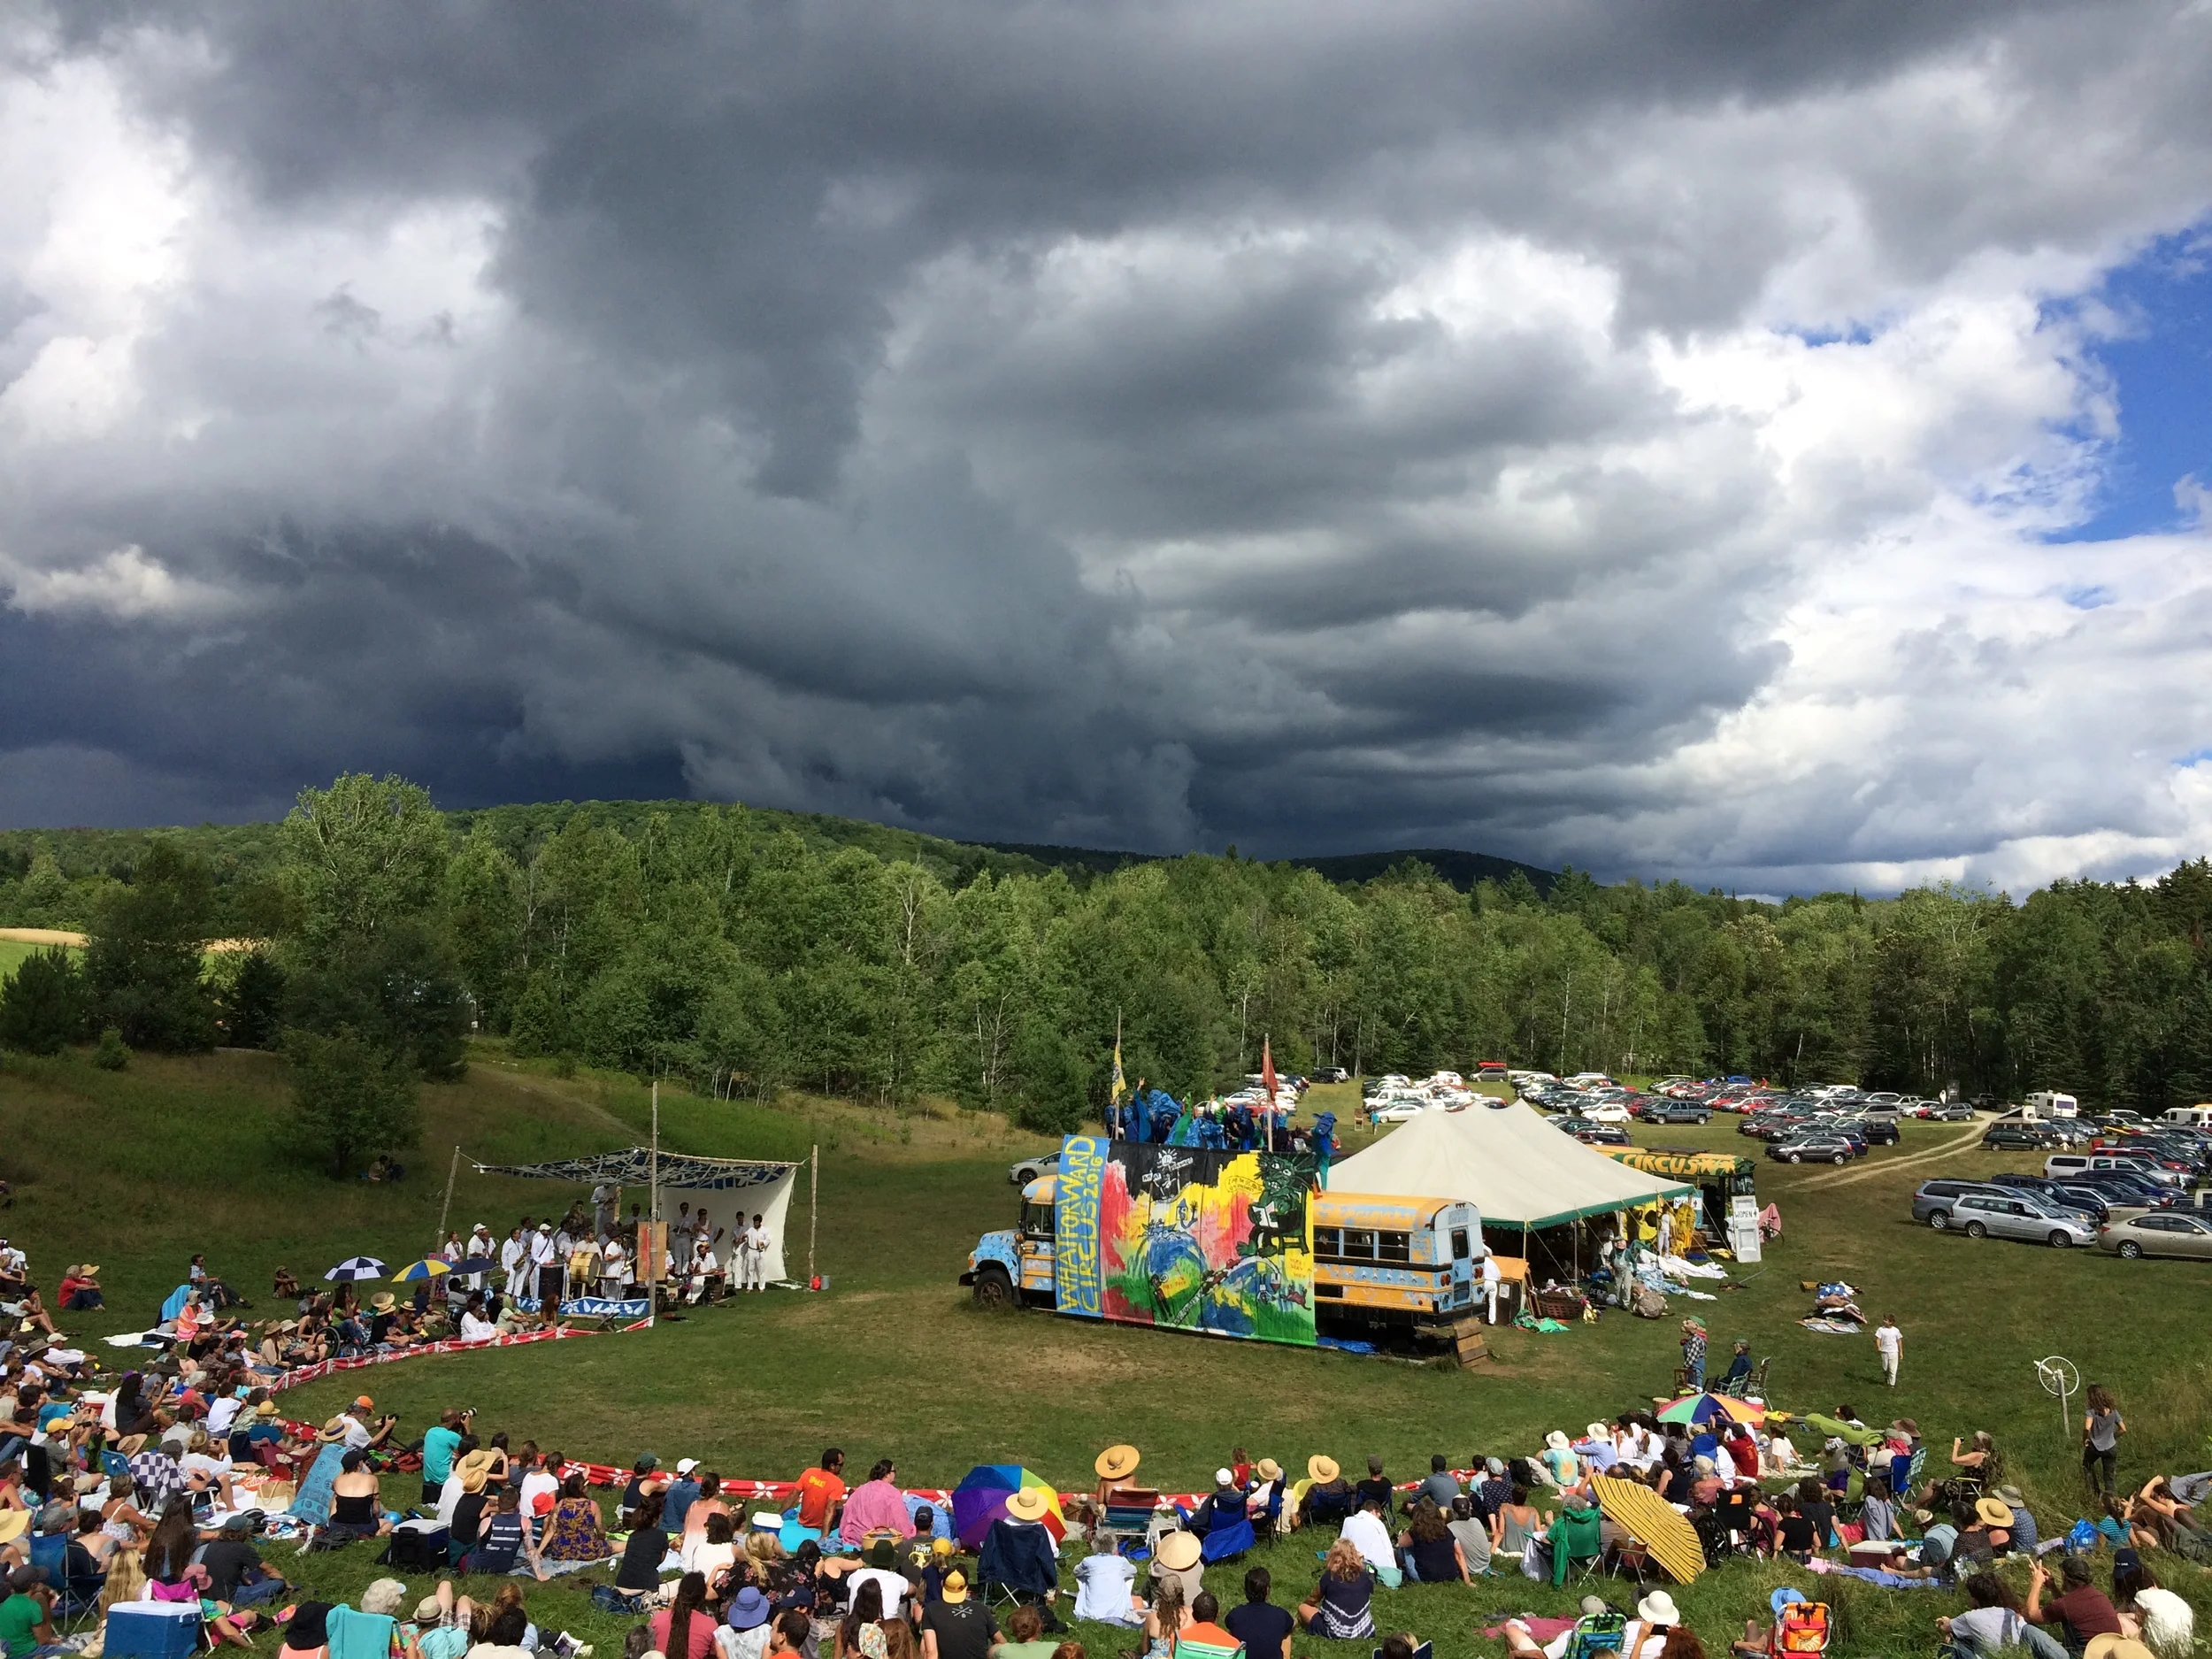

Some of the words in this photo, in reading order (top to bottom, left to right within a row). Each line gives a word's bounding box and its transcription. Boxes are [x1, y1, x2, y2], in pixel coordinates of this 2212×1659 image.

[1083, 1156, 1103, 1199] 2016
[1623, 1154, 1700, 1175] CIRCUS
[1077, 1201, 1099, 1312] CIRCUS
[914, 1544, 932, 1554] Trapp
